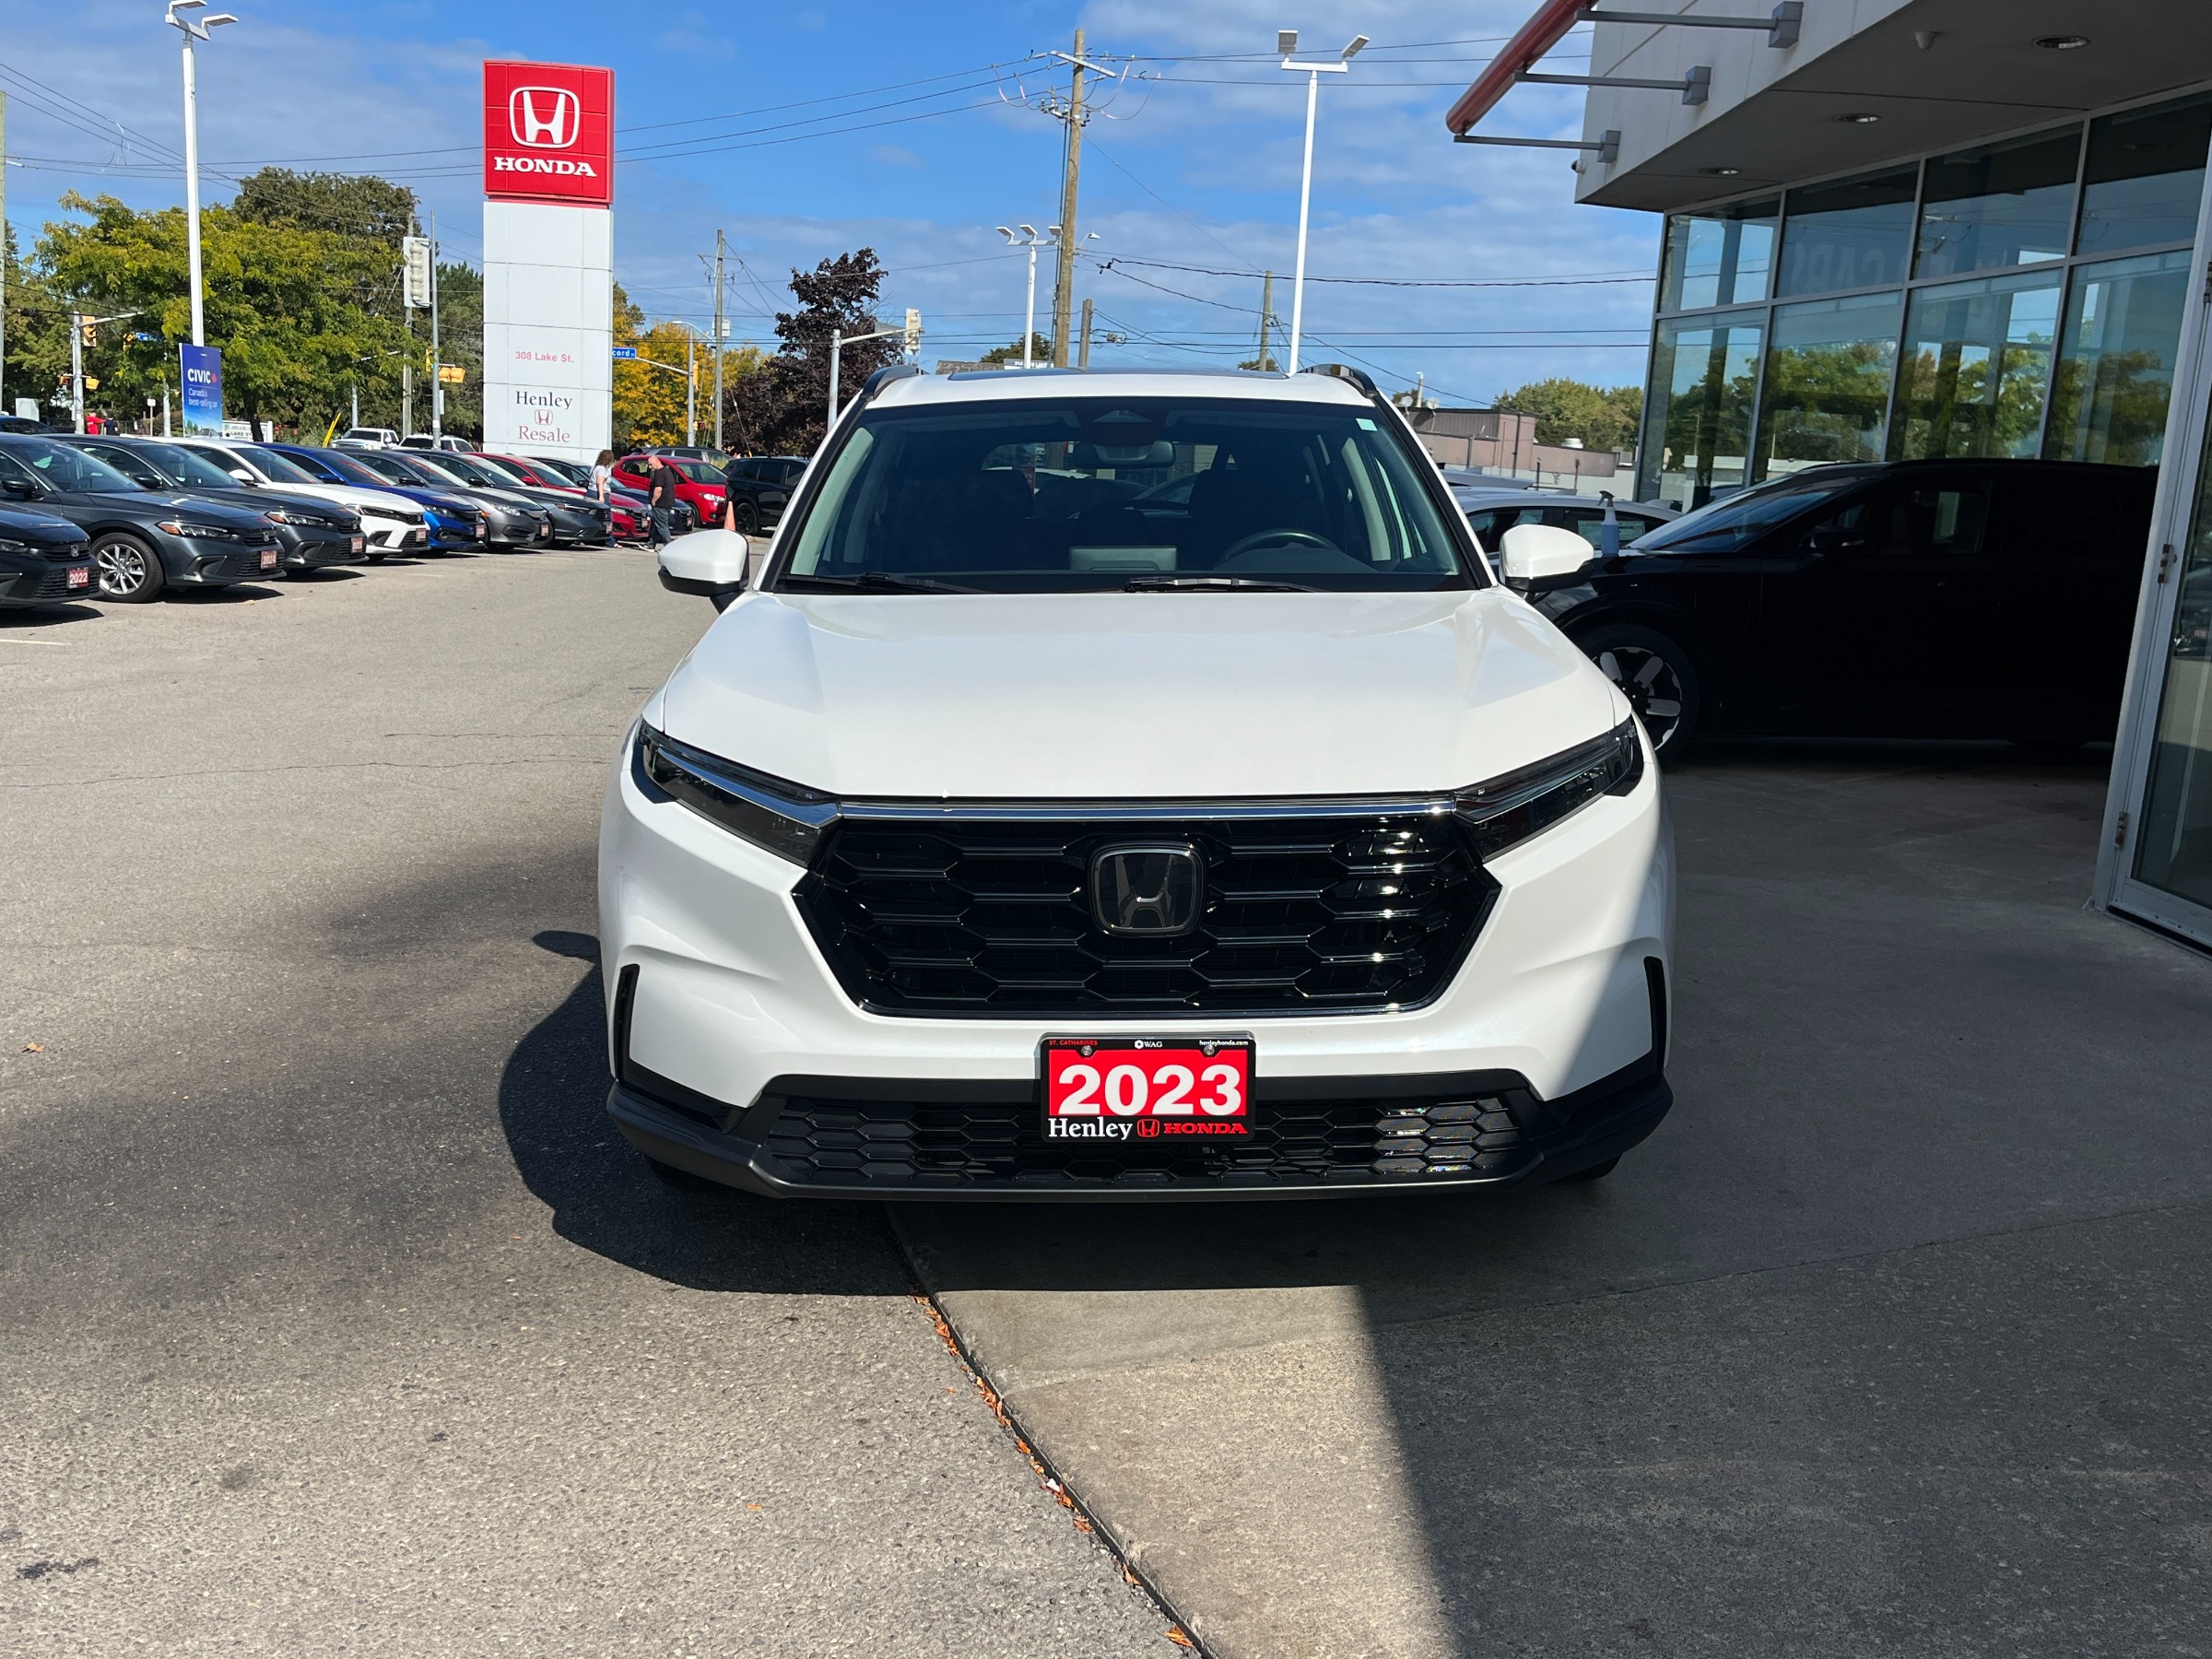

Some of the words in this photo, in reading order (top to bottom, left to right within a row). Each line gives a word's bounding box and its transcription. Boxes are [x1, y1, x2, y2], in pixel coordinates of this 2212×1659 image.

[494, 157, 597, 177] HONDA
[515, 351, 532, 359] 308
[535, 352, 558, 361] Lake
[560, 354, 574, 363] St.
[187, 368, 211, 384] CIVIC
[515, 391, 573, 410] Henley
[518, 426, 571, 442] Resale
[69, 571, 88, 584] 2022
[1057, 1064, 1241, 1116] 2023
[1048, 1116, 1134, 1141] Henley
[1163, 1123, 1248, 1135] HONDA
